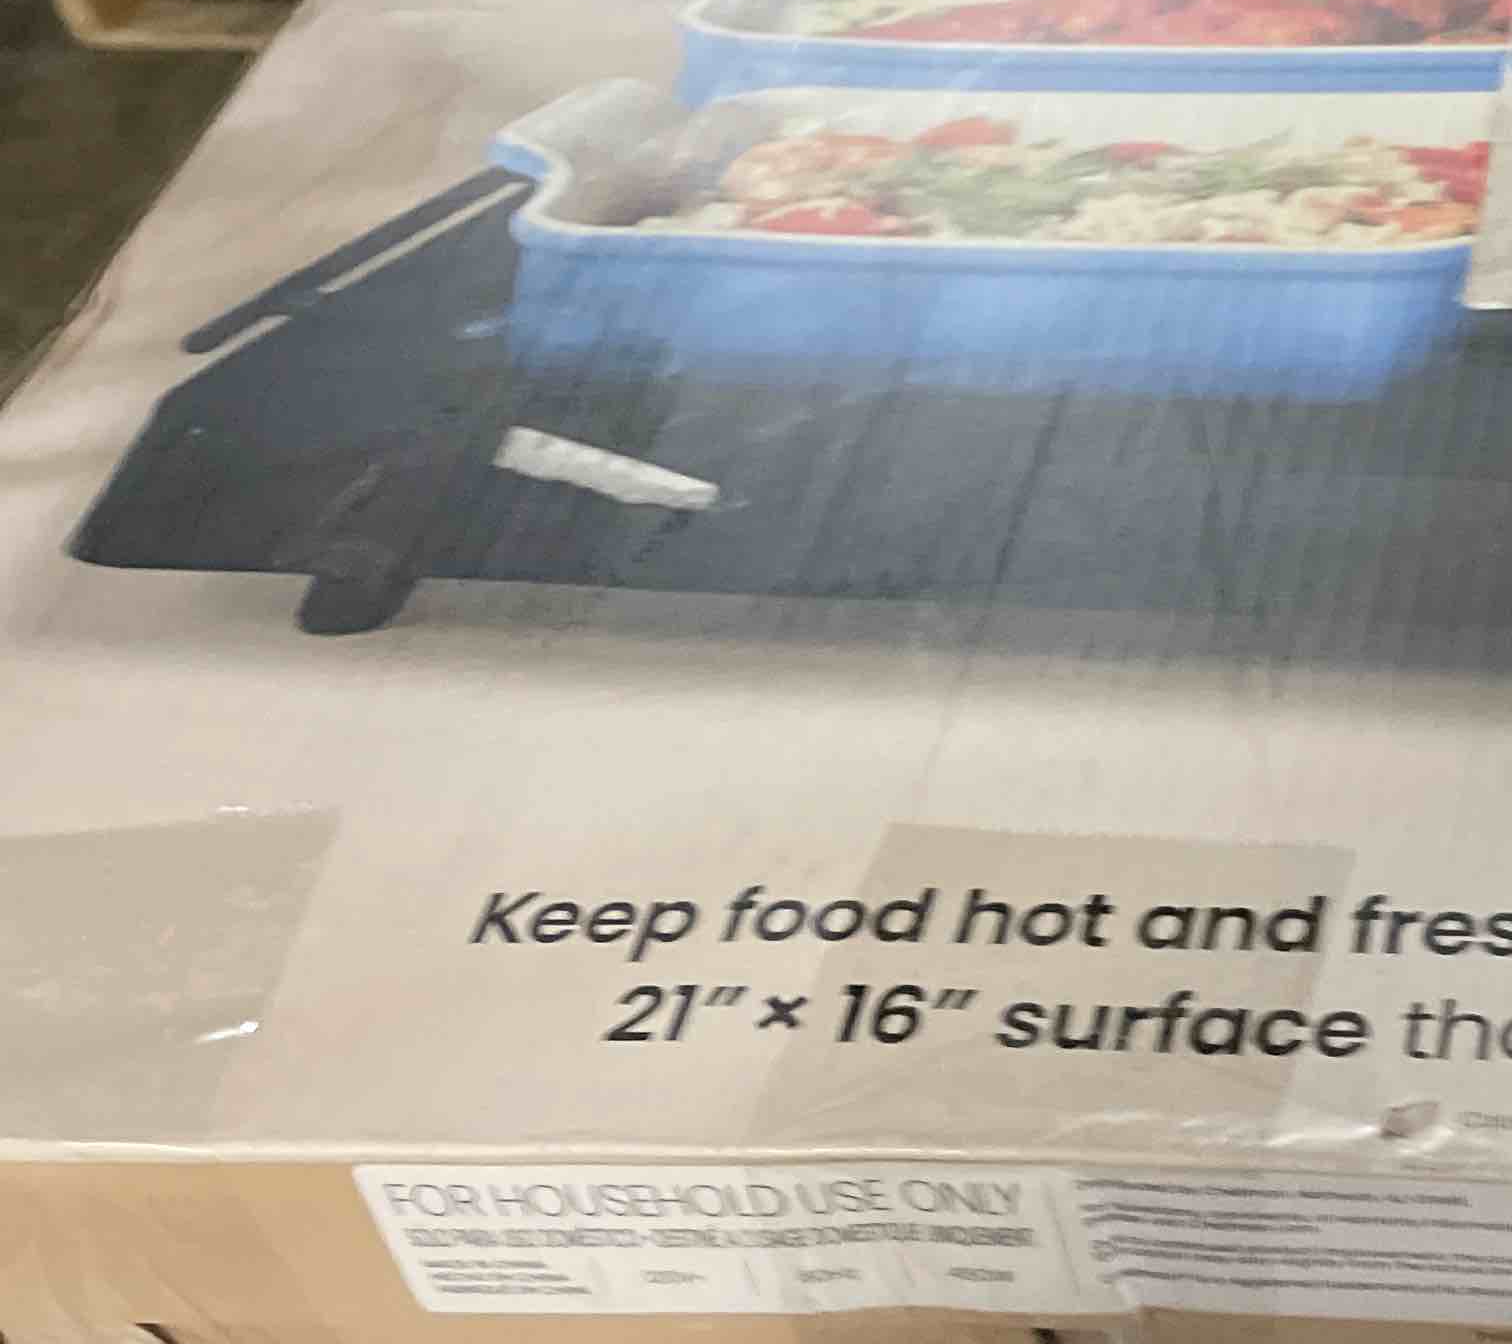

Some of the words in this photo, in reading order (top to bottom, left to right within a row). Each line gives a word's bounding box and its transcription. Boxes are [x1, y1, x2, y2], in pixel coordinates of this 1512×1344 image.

[468, 889, 698, 962] Keep
[718, 885, 940, 945] food
[950, 888, 1117, 949] hot
[1138, 895, 1328, 953] and
[996, 991, 1371, 1057] surface
[382, 1182, 488, 1217] FOR
[490, 1181, 790, 1218] HOUSEHOLD
[795, 1178, 893, 1216] USE
[900, 1178, 1020, 1216] ONLY
